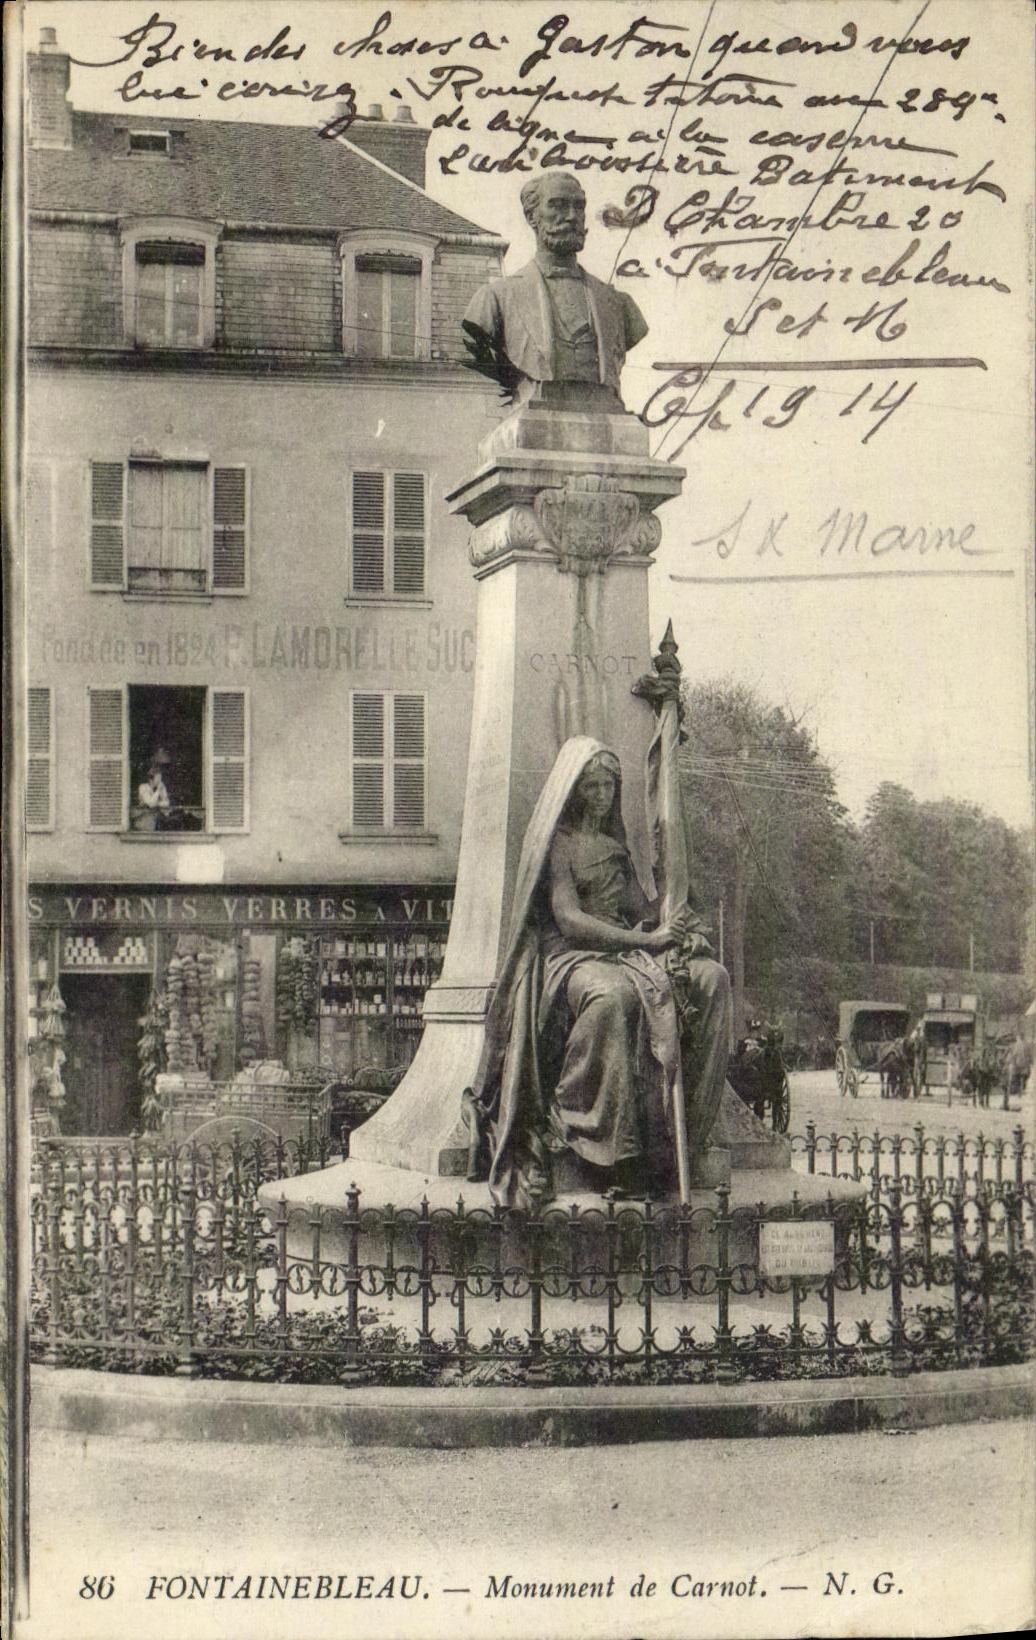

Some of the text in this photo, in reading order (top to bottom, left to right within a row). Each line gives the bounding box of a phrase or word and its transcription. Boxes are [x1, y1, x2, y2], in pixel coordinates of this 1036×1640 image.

[519, 14, 690, 78] Gaston
[701, 22, 857, 80] quand
[864, 36, 970, 60] vous
[817, 507, 1003, 556] Marne
[529, 652, 637, 675] CARNOT
[64, 896, 198, 921] VERNIS
[222, 896, 358, 922] VERRES
